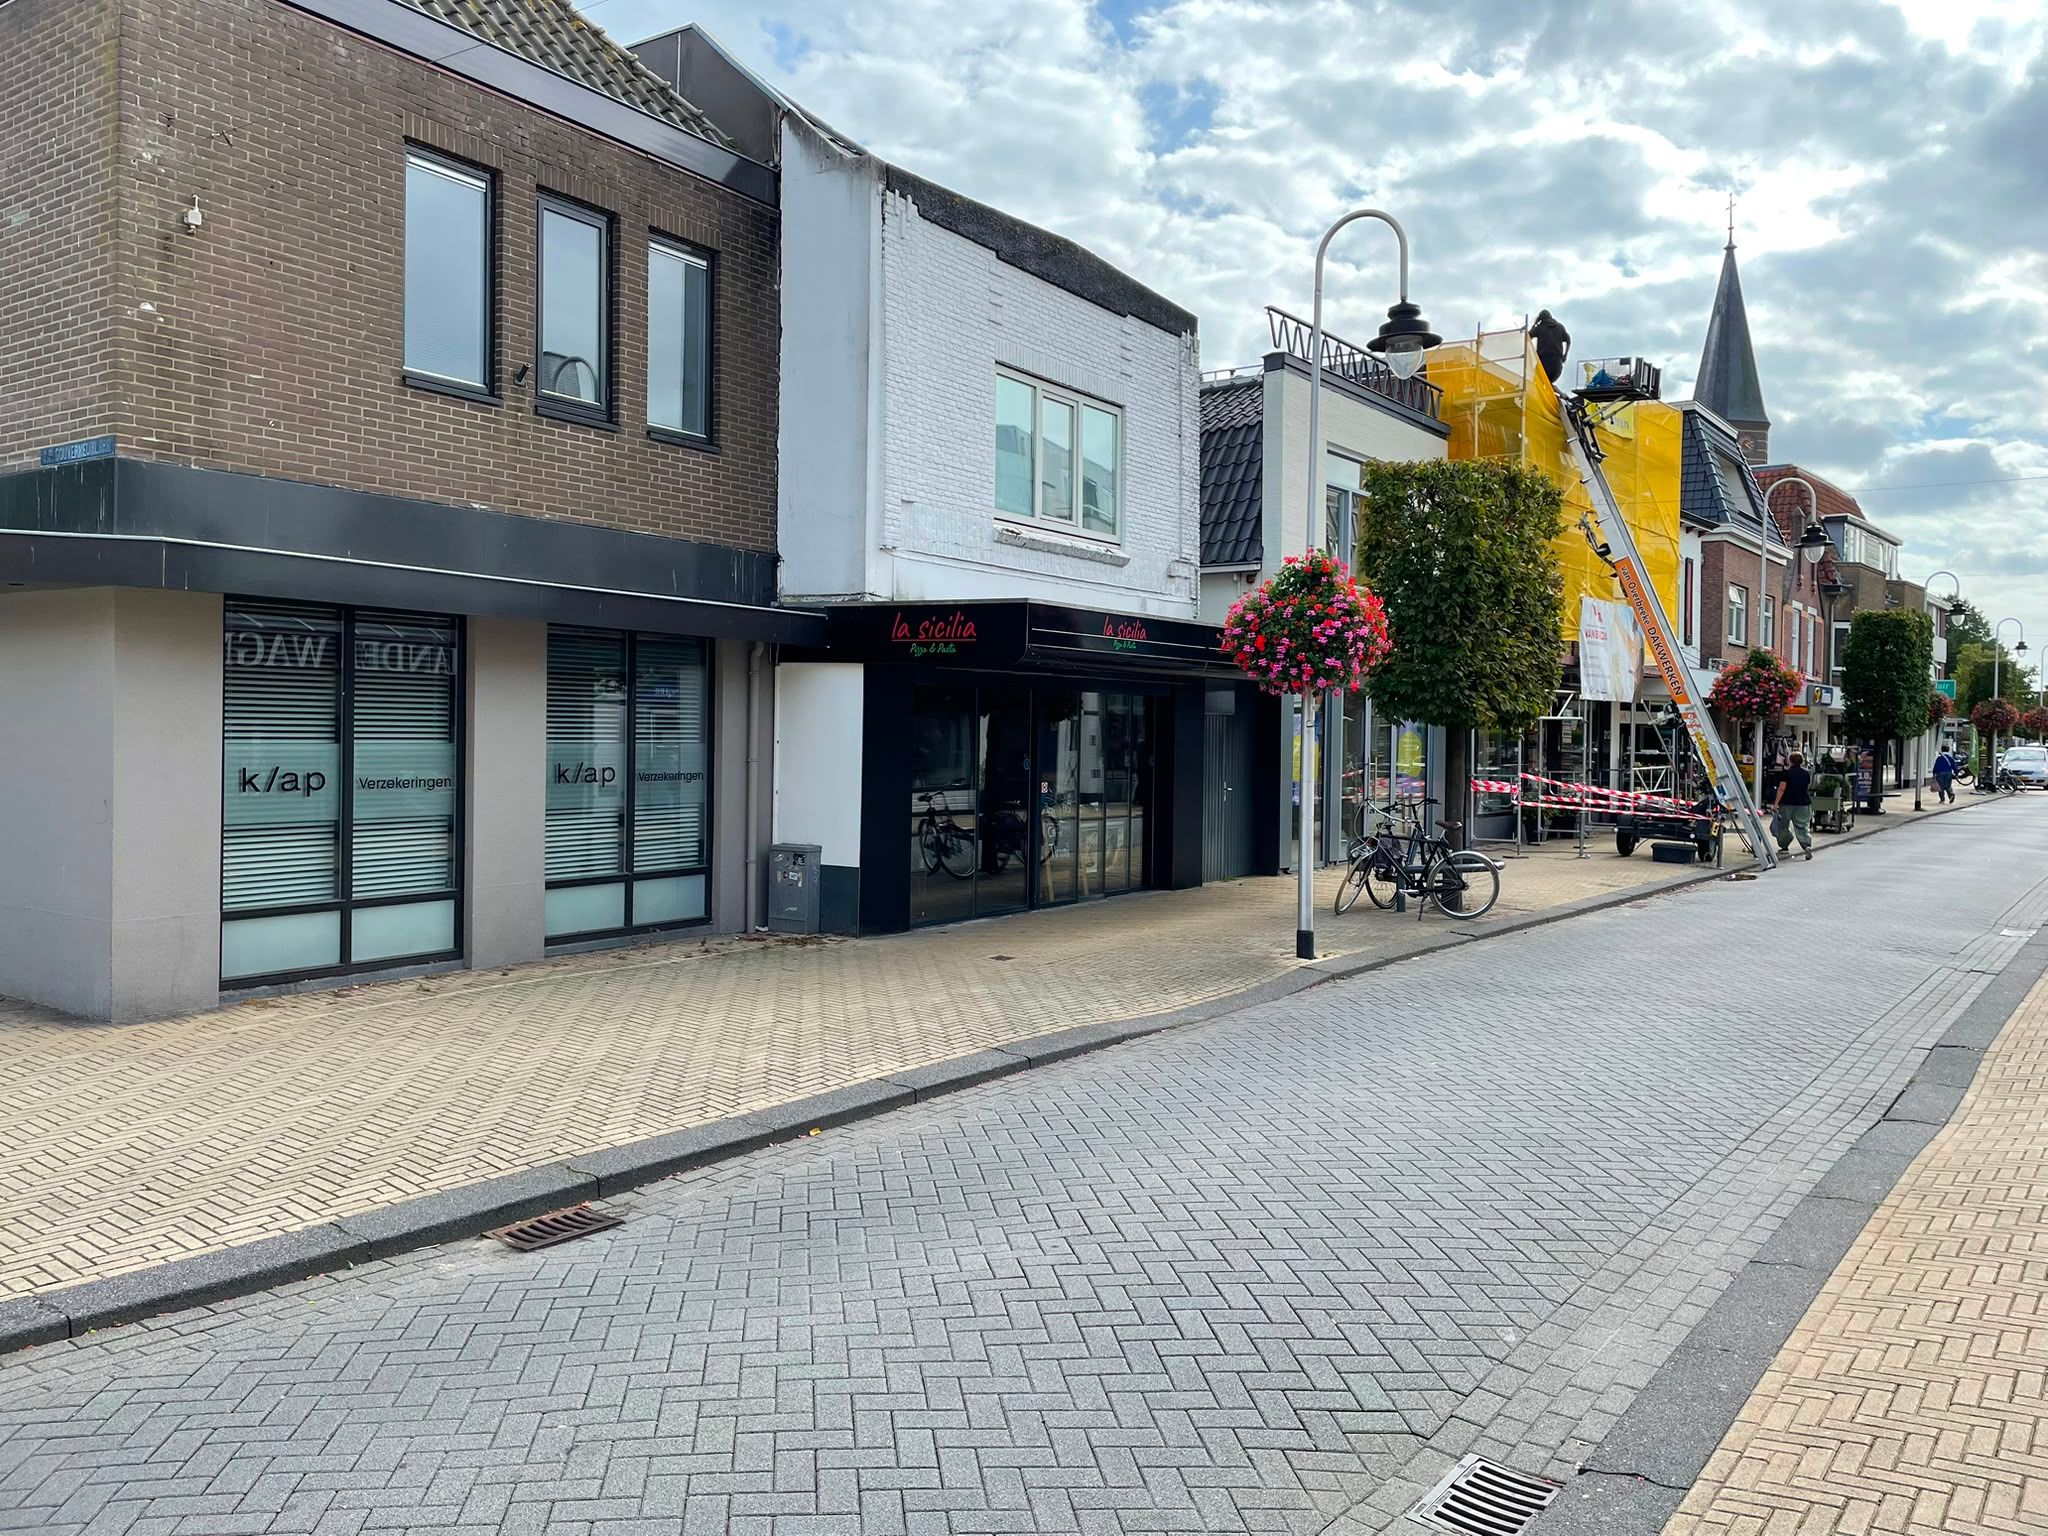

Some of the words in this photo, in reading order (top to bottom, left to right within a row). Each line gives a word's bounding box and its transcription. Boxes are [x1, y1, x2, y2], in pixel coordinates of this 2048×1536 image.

[892, 611, 910, 638] la
[918, 610, 976, 639] sicilia
[1103, 616, 1114, 636] la
[1117, 619, 1147, 640] sicilia
[1620, 566, 1631, 581] van
[1627, 582, 1650, 625] Overbeeke
[1647, 626, 1684, 696] DAKWERKEN
[910, 643, 927, 656] Pizza
[937, 643, 956, 653] Pasta
[241, 766, 326, 797] k/ap
[359, 776, 452, 791] Verzekeringen
[556, 762, 616, 788] k/ap
[638, 771, 704, 783] Verzekeringen
